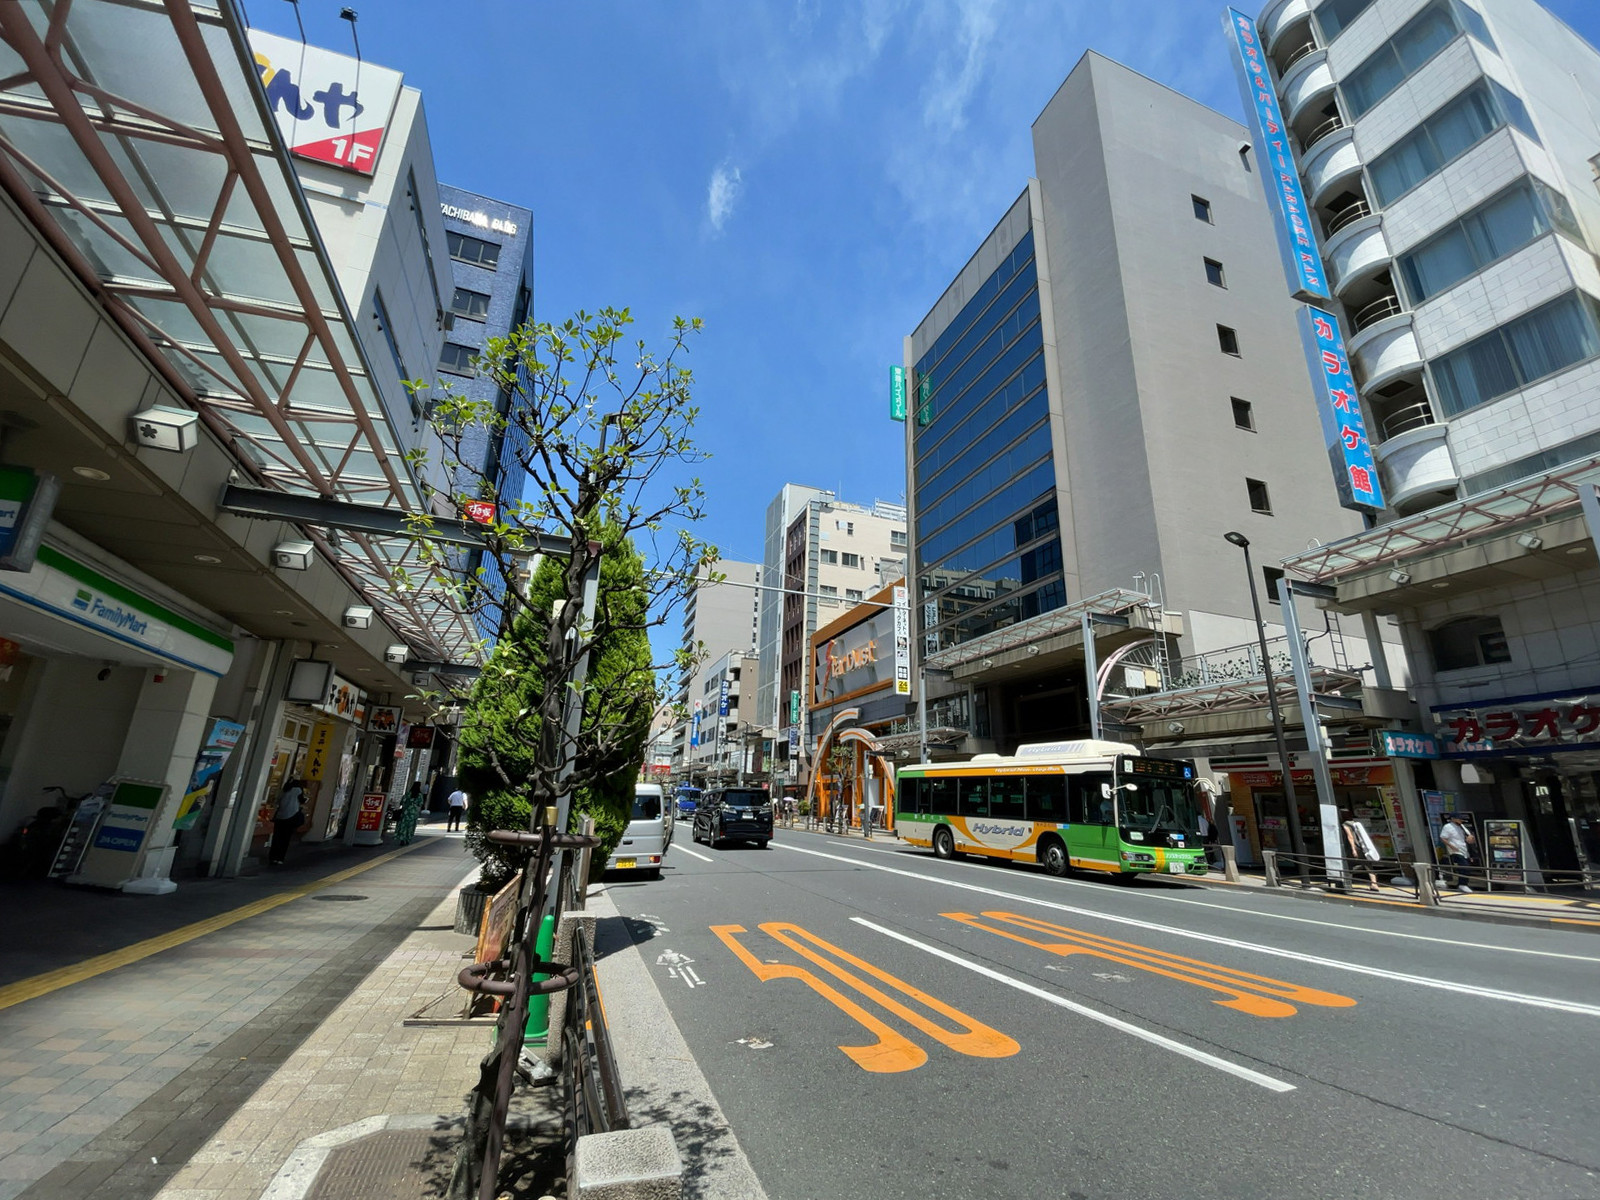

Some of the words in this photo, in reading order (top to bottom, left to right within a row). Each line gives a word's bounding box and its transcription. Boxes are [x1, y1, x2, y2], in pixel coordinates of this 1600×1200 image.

[332, 138, 374, 163] 1F
[1280, 173, 1310, 248] KARAOKE
[1300, 252, 1320, 287] KAN
[1314, 316, 1373, 494] カラオケ館
[90, 598, 148, 635] FamilyMart
[721, 680, 729, 709] カラオケ
[1448, 704, 1600, 745] カラオケ
[1027, 745, 1061, 753] Hybrid
[972, 822, 1025, 837] Hybrid
[708, 921, 1022, 1074] 50
